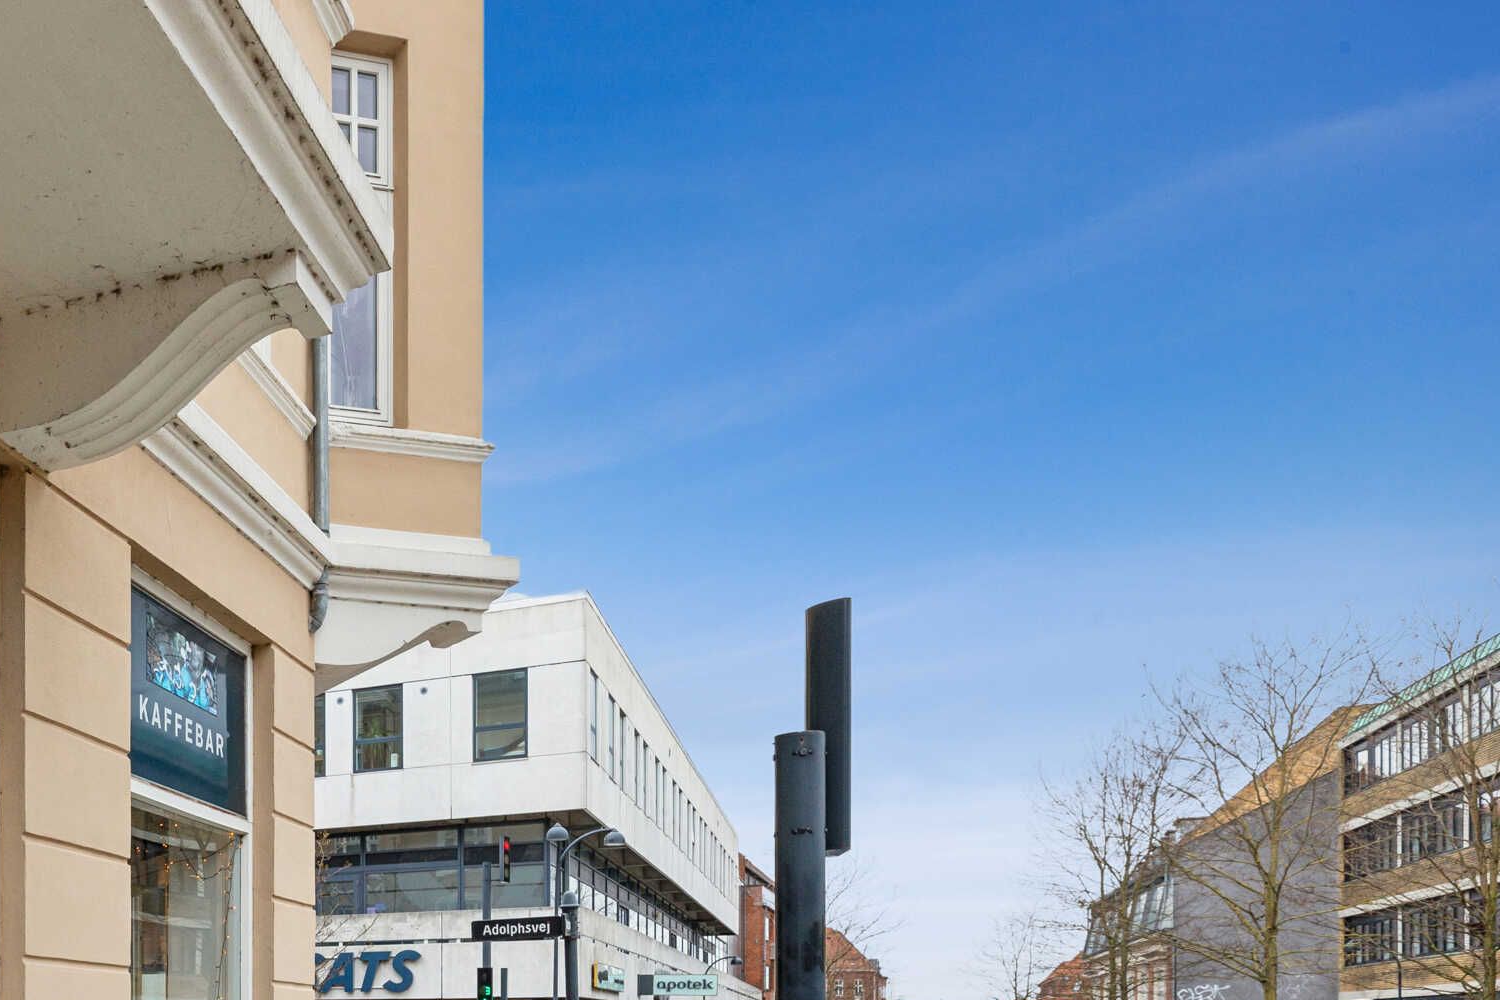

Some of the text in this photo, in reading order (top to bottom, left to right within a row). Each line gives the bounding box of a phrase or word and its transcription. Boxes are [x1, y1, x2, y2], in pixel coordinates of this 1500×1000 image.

[139, 693, 225, 759] KAFFEBAR
[483, 922, 550, 937] Adolphsvej
[315, 949, 422, 994] ATS
[656, 978, 714, 992] apotek
